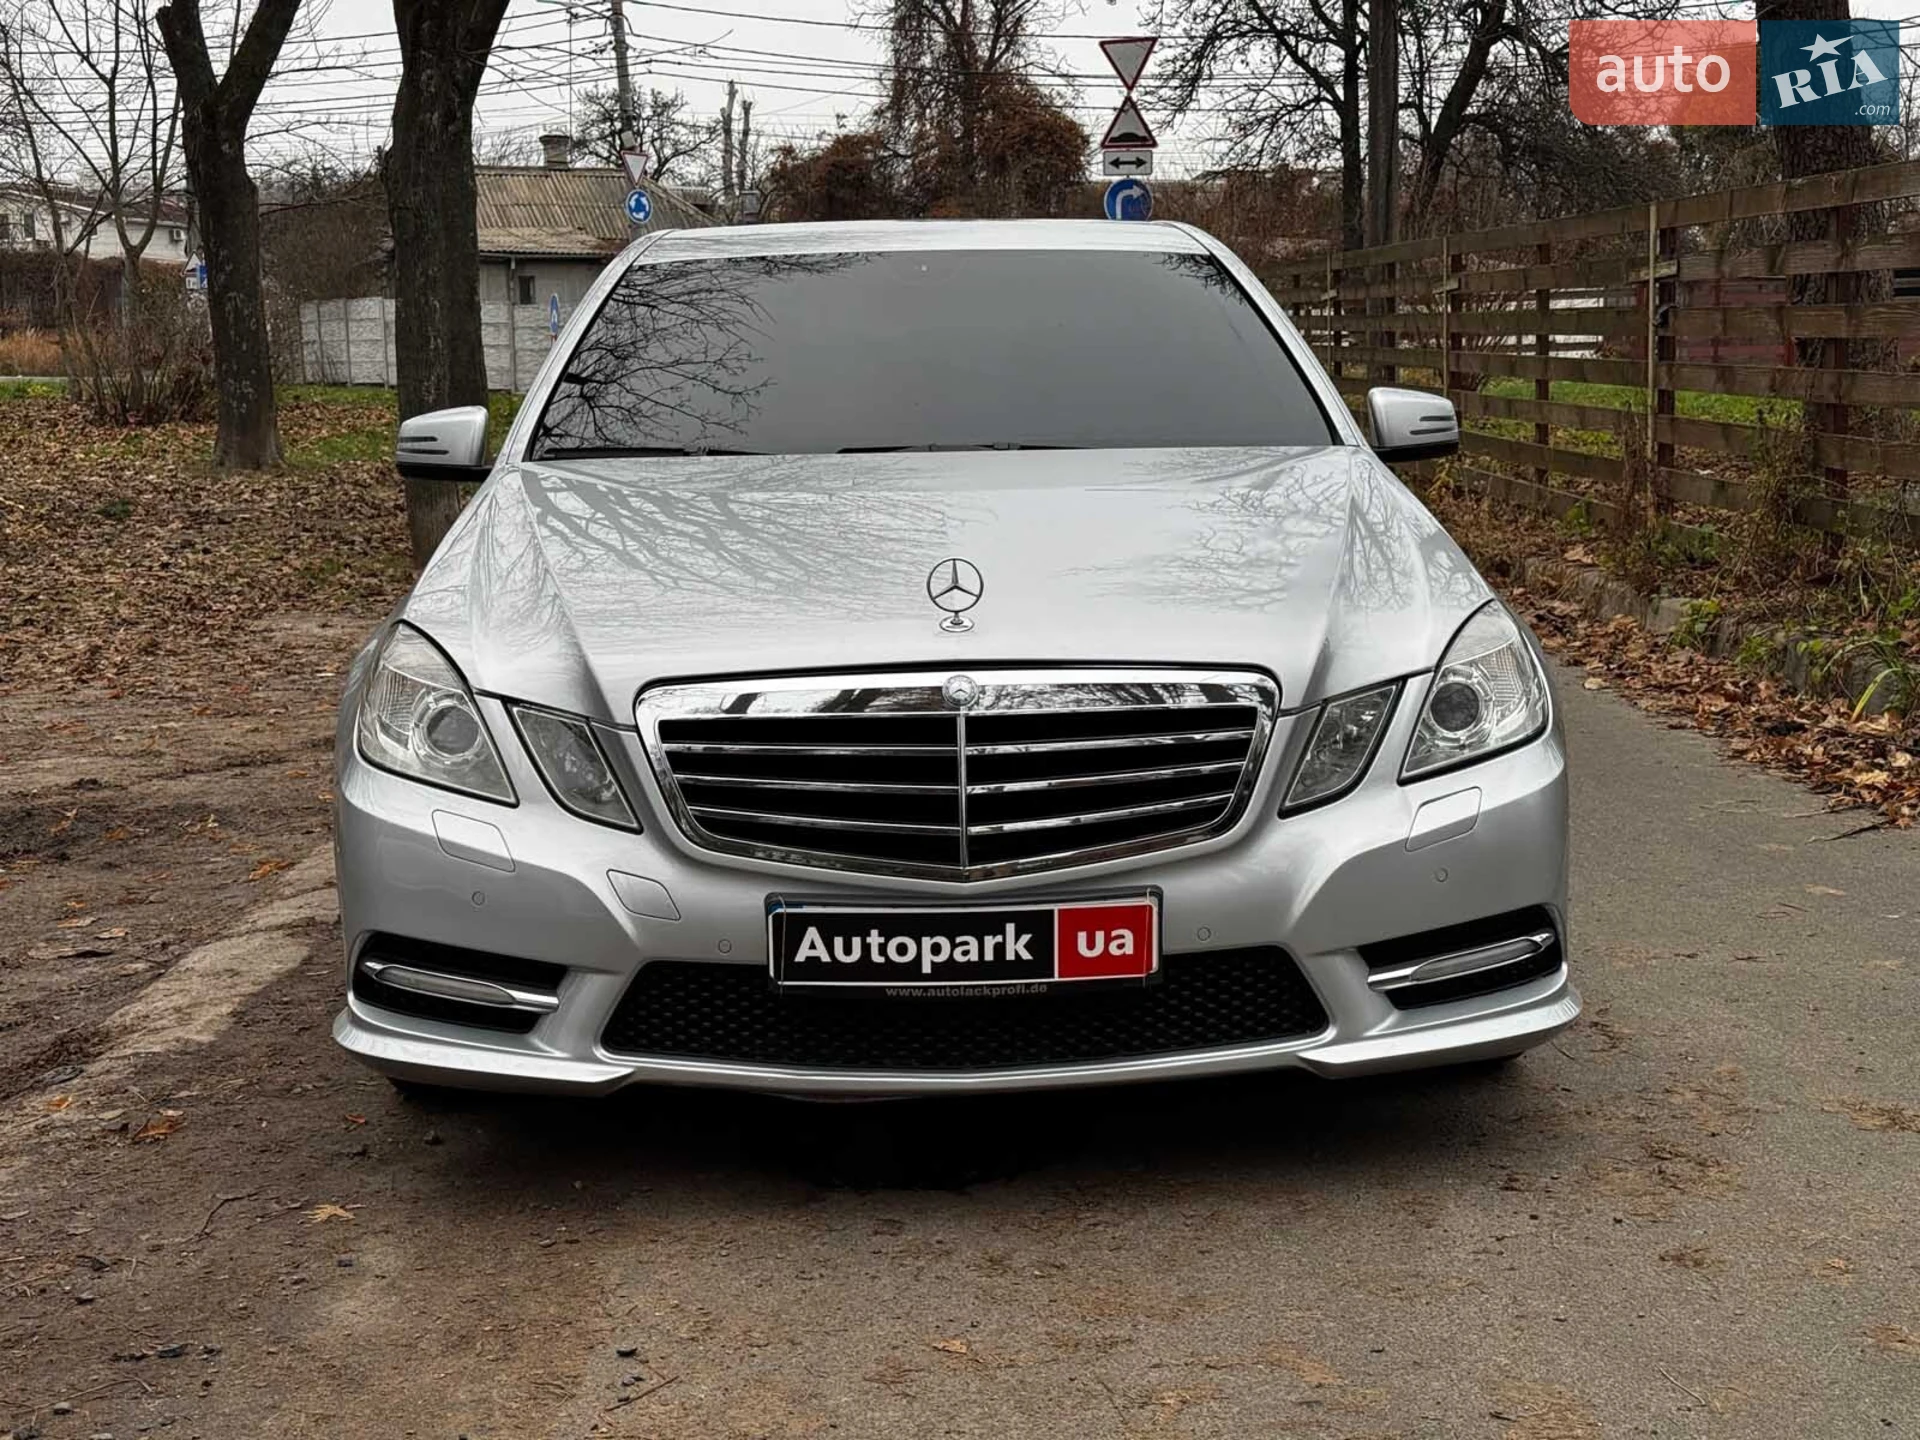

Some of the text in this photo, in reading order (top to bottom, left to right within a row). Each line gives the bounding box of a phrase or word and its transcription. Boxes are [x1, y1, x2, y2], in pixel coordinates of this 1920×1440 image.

[794, 923, 1134, 974] Autopark ua
[885, 983, 1048, 998] www.autolackprofi.de
